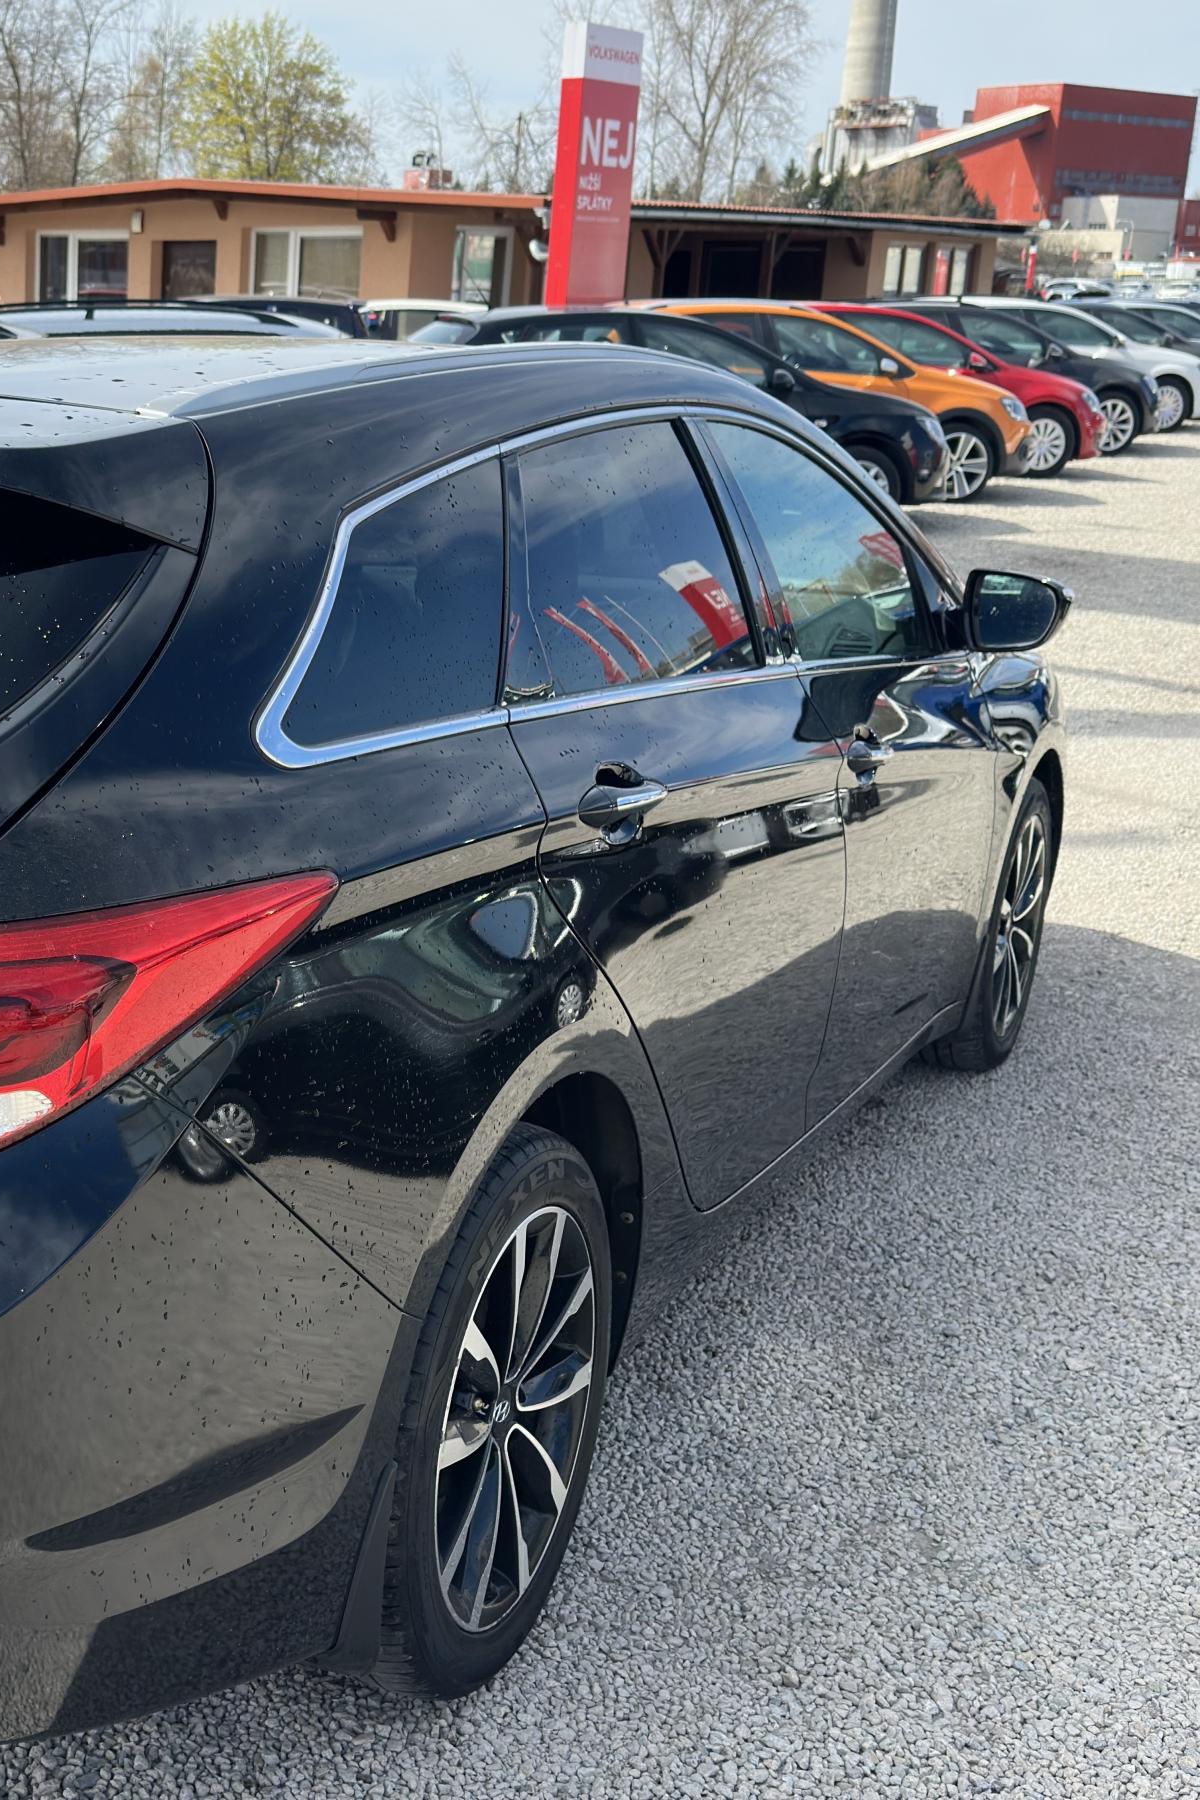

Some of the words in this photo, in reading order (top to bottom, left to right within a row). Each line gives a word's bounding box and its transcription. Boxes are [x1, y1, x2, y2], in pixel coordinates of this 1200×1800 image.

[589, 44, 640, 64] VOLKSWAGEN
[581, 116, 634, 169] NEJ
[577, 193, 613, 211] SPLÁTKY
[467, 1159, 565, 1289] NEXEN
